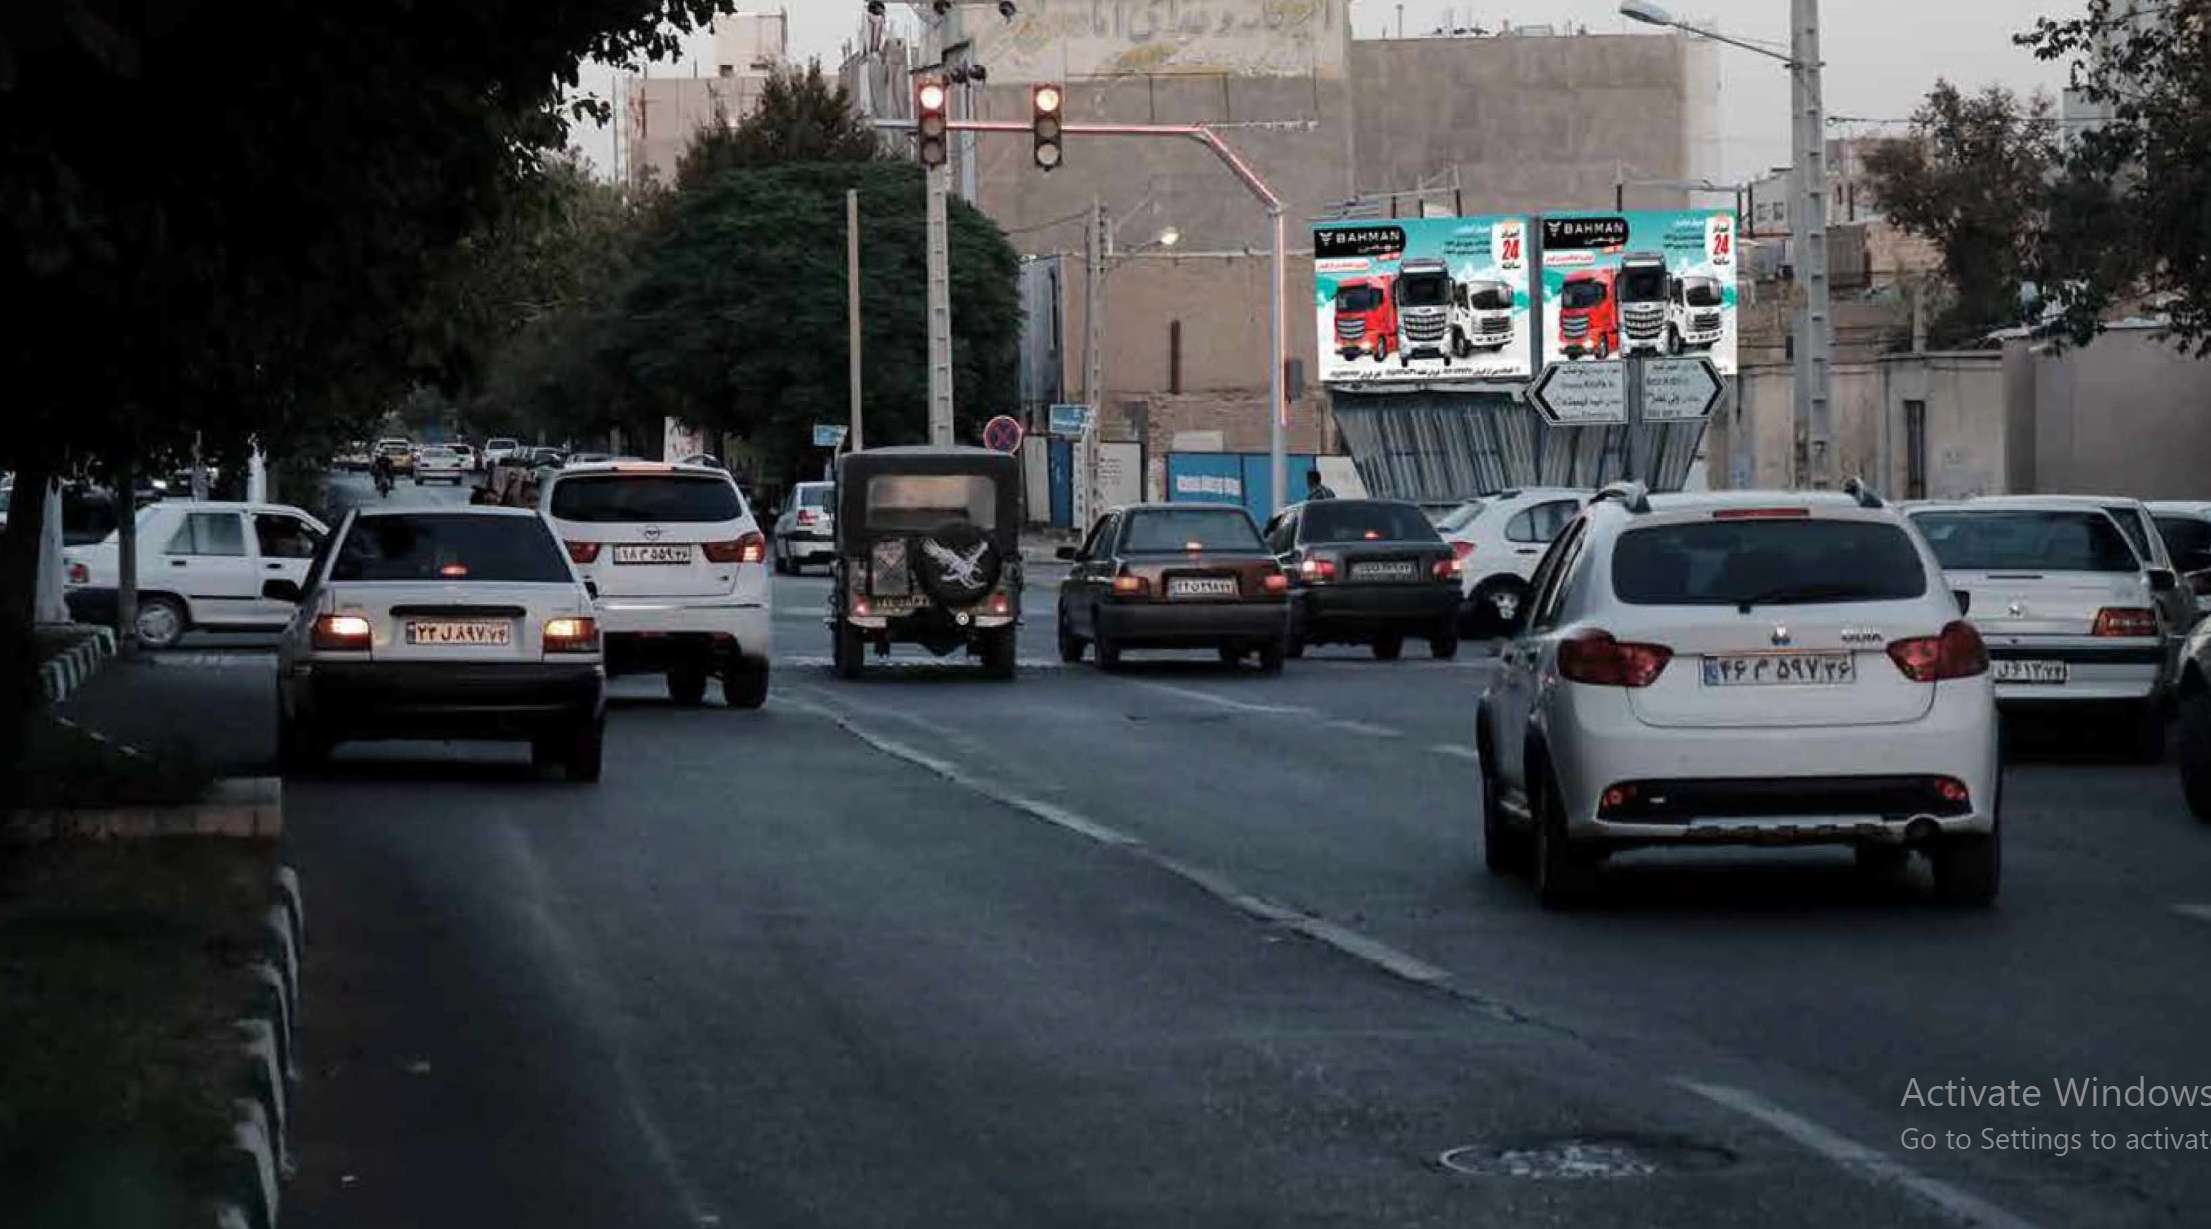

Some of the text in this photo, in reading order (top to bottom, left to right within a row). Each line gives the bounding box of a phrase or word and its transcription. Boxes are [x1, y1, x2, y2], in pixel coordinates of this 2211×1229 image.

[1563, 221, 1624, 235] BAHMAN
[1336, 230, 1400, 244] BAHMAN
[1714, 233, 1730, 255] 24
[1502, 239, 1520, 260] 24
